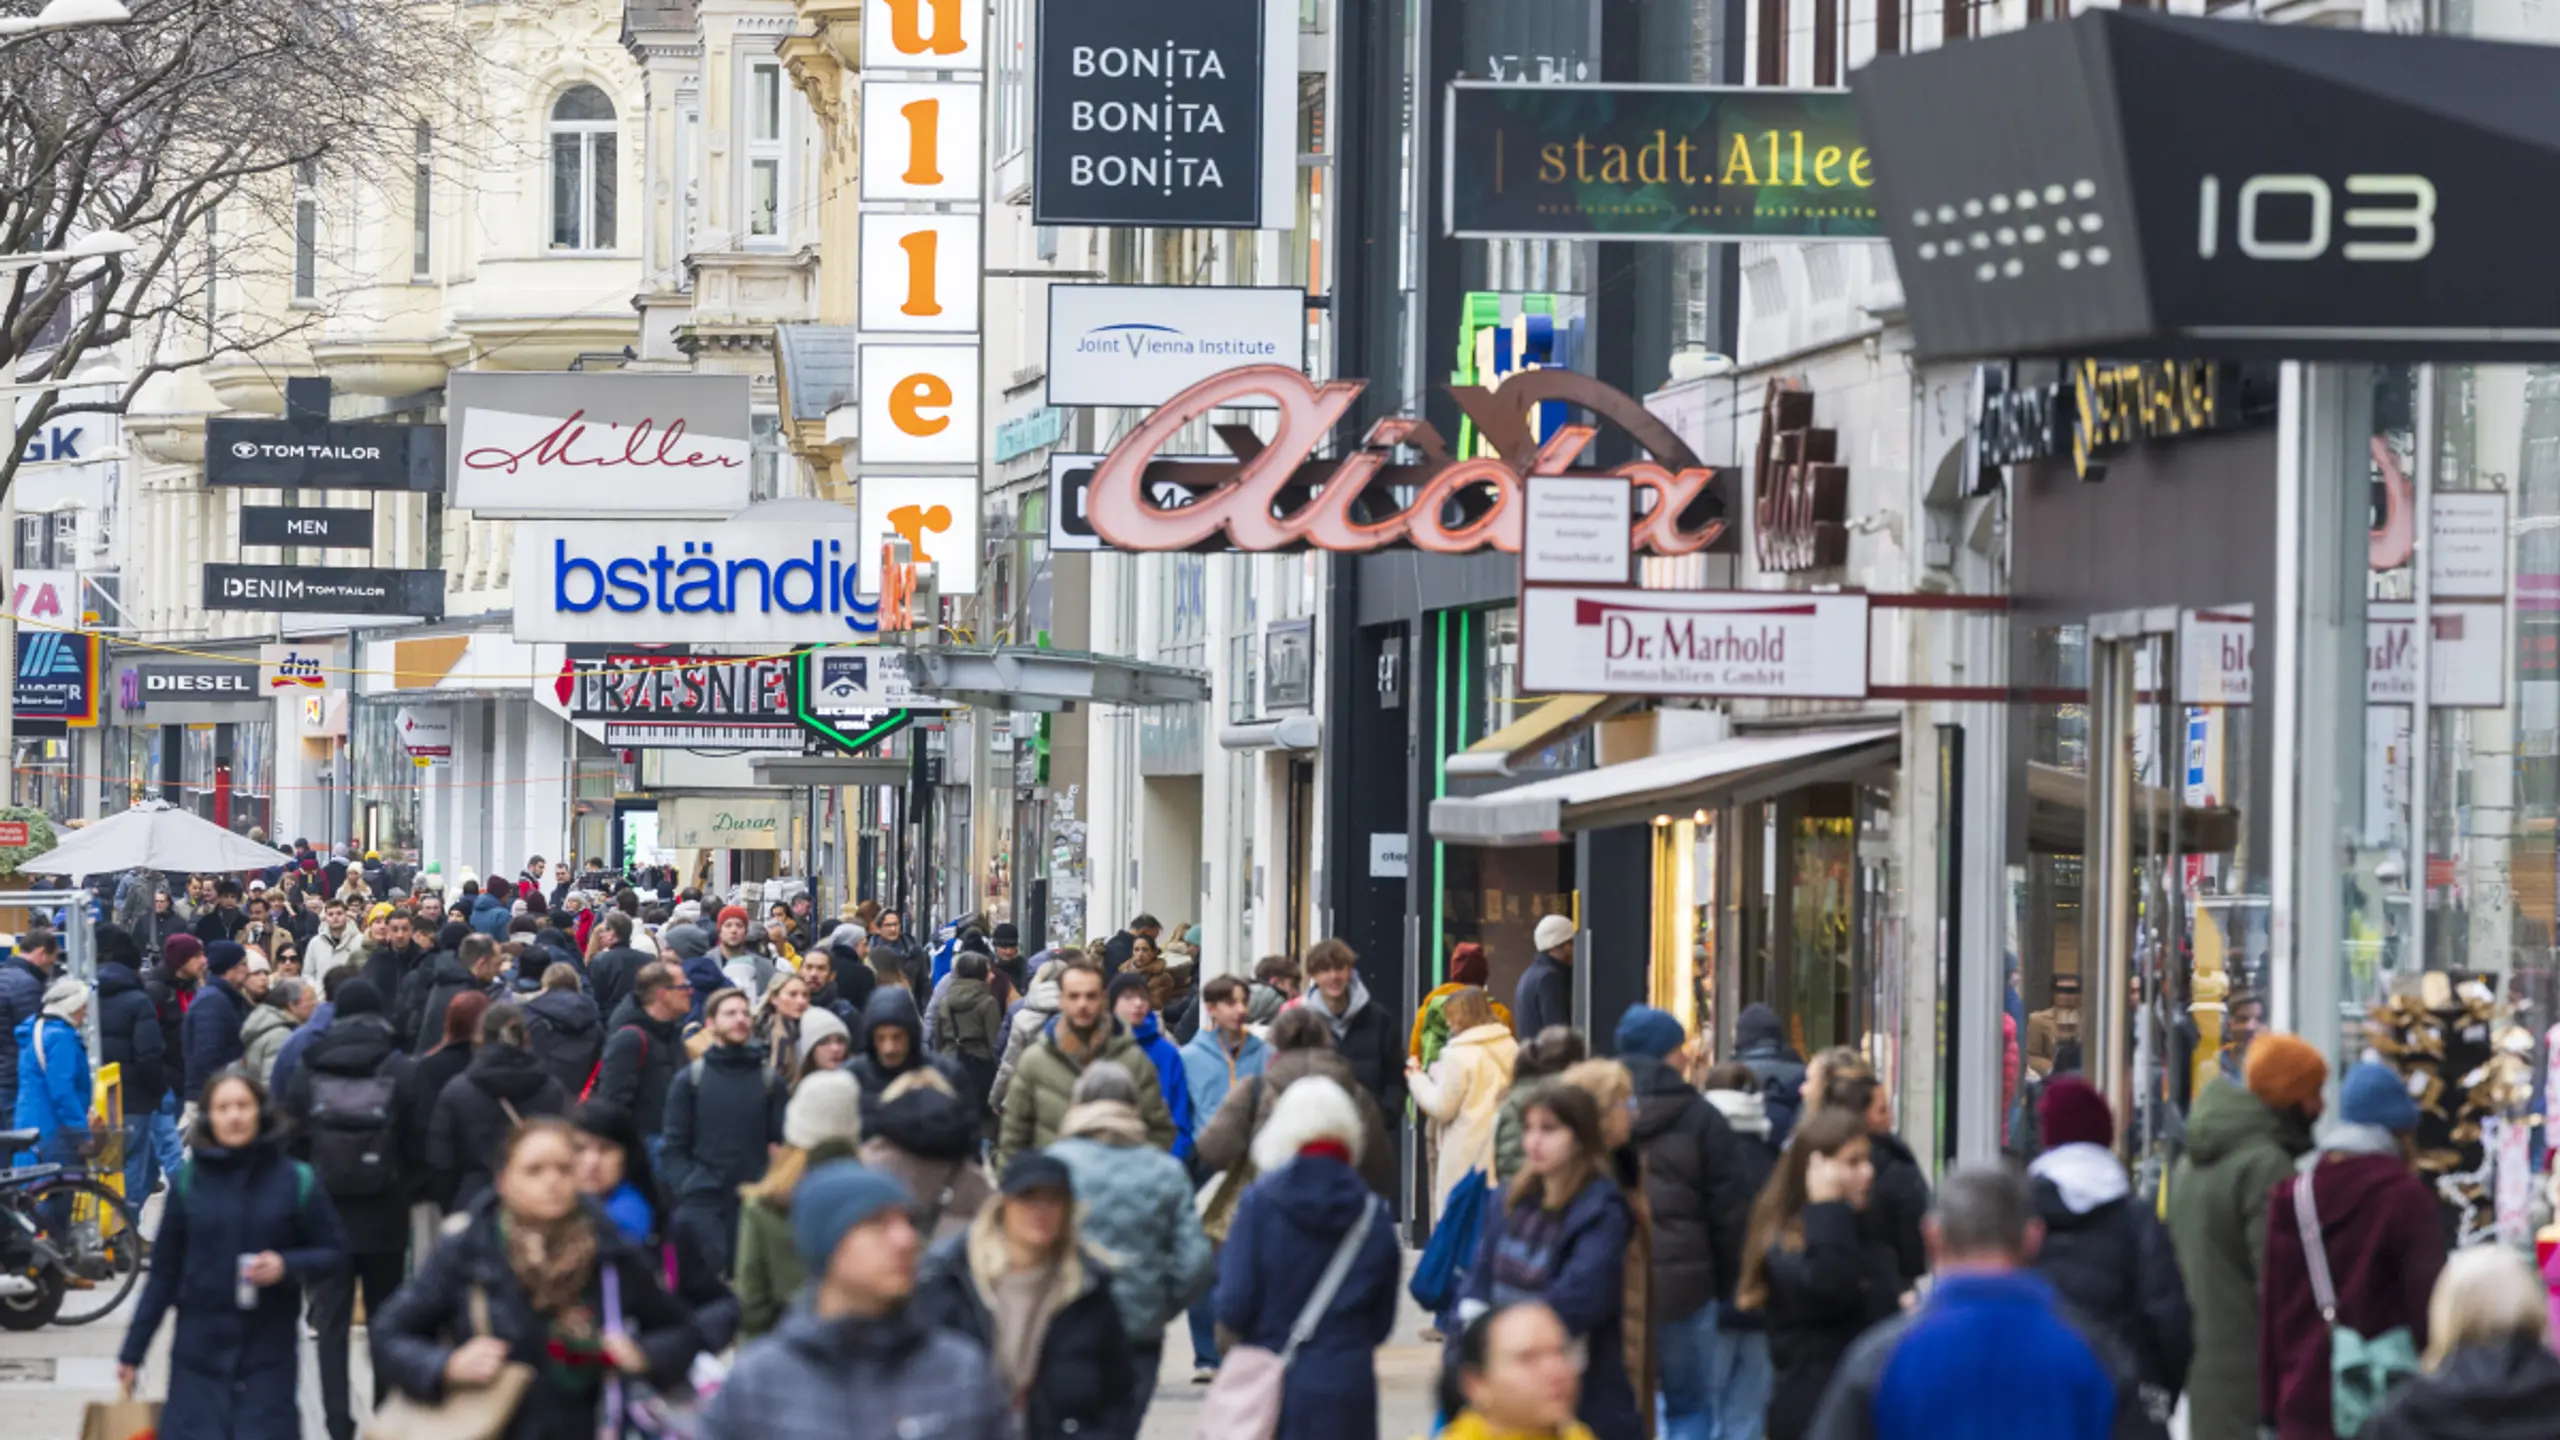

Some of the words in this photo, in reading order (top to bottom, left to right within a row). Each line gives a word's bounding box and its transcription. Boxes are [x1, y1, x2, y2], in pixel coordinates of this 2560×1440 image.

[1072, 40, 1226, 88] BONITA
[1071, 94, 1226, 142] BONITA
[1538, 129, 1876, 187] stadt.Allee
[1070, 148, 1224, 196] BONITA
[2198, 174, 2438, 261] 103
[1076, 337, 1120, 353] Joint
[1125, 332, 1195, 359] Vienna
[1199, 338, 1276, 355] Institute
[260, 444, 304, 458] TOM
[307, 445, 381, 460] TAILOR
[464, 409, 744, 474] Miller
[287, 519, 329, 535] MEN
[223, 577, 304, 599] DENIM
[306, 584, 336, 595] TOM
[338, 586, 386, 597] TAILOR
[1605, 614, 1652, 661] Dr.
[1659, 616, 1786, 664] Marhold
[279, 651, 320, 676] dm
[1604, 662, 1715, 683] Immobilien
[1722, 667, 1786, 686] GmbH
[146, 674, 251, 691] DIESEL
[712, 812, 778, 832] Duran
